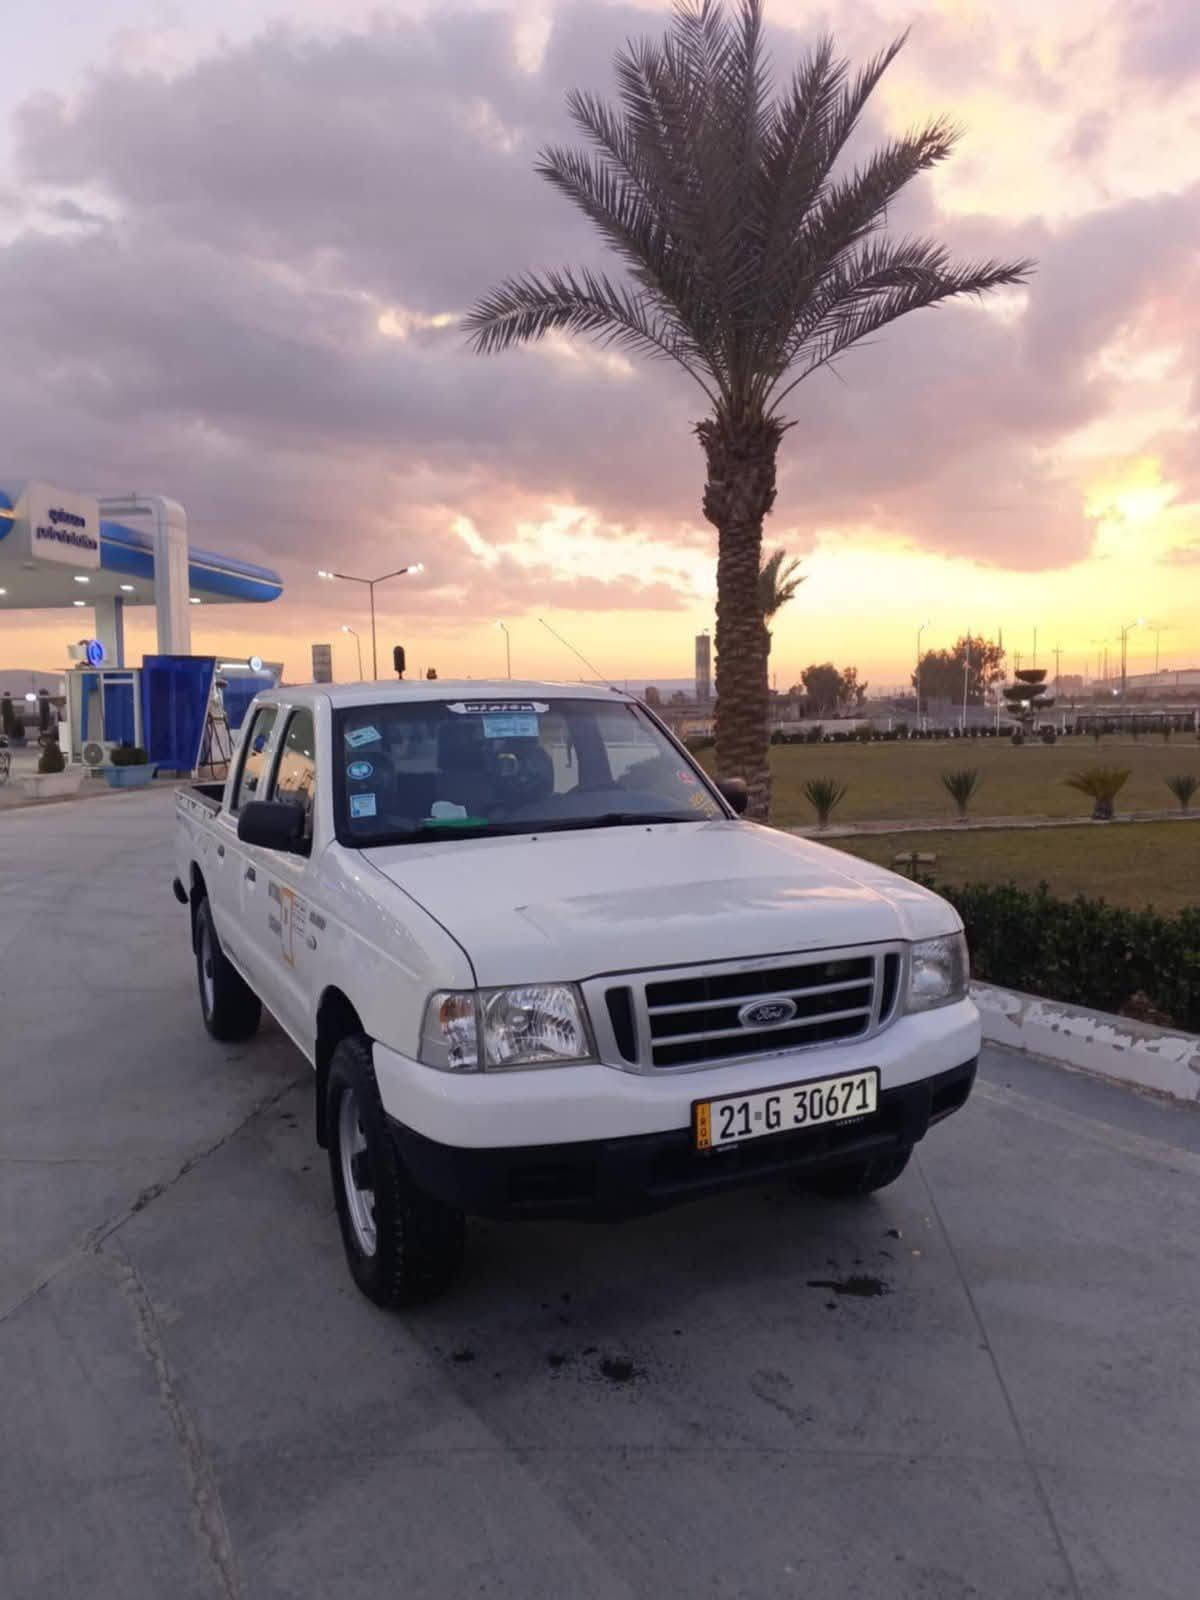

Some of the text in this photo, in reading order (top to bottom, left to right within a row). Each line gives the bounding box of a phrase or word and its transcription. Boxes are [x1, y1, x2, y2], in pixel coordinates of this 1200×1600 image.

[756, 1005, 785, 1021] Ford
[719, 1078, 869, 1140] 21 G 30671
